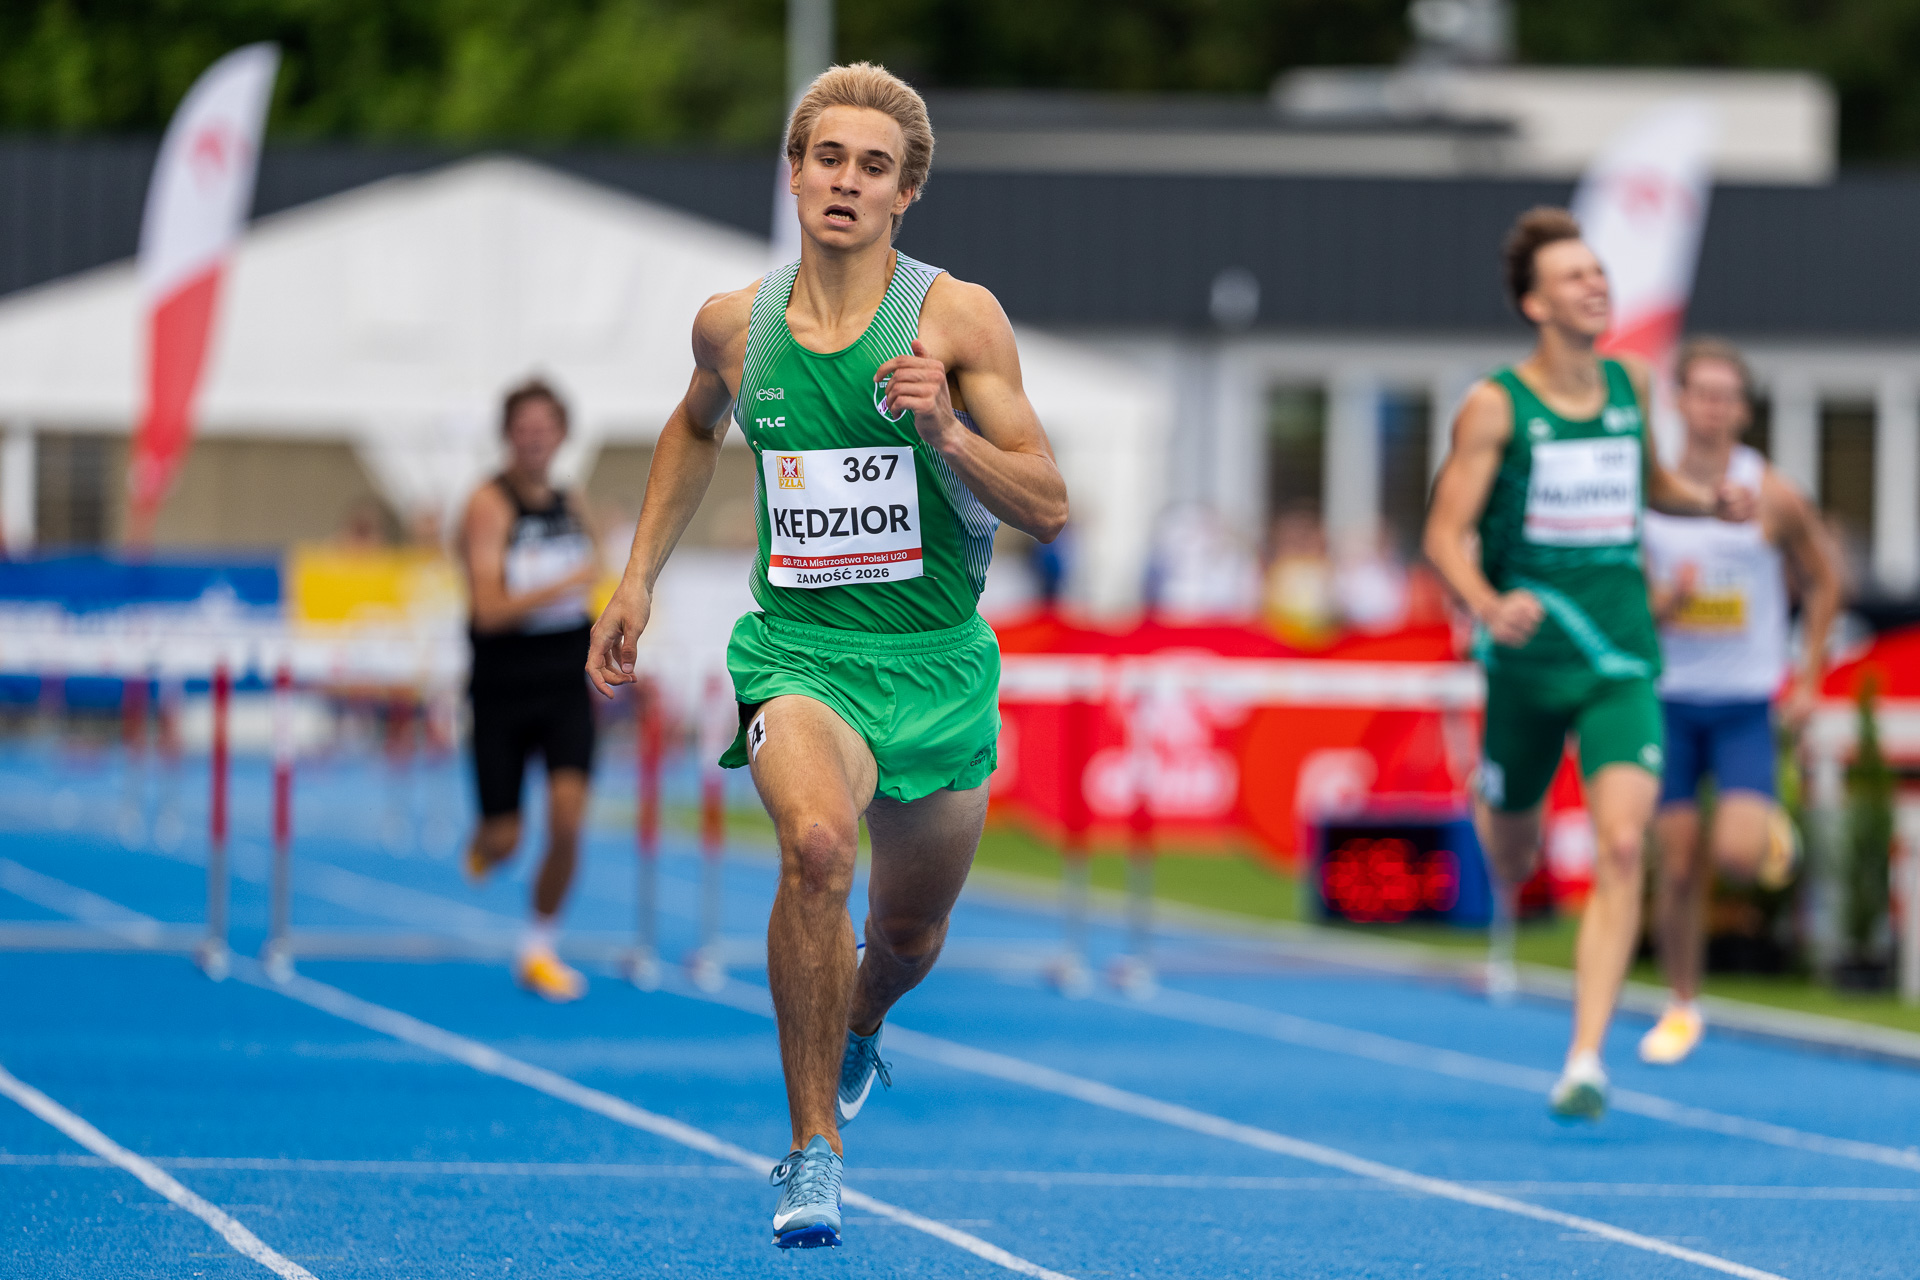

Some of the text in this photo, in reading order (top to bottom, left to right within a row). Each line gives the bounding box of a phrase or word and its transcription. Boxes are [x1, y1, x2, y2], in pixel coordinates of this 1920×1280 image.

[755, 387, 785, 401] esa
[755, 416, 786, 429] TLC
[843, 454, 899, 483] 367
[780, 478, 804, 488] PZLA
[773, 504, 912, 545] KĘDZIOR
[809, 556, 862, 567] Mistrzostwa
[863, 553, 889, 563] Polski
[890, 551, 908, 561] U20
[796, 567, 890, 584] ZAMOŚĆ 2026
[751, 720, 764, 751] 4
